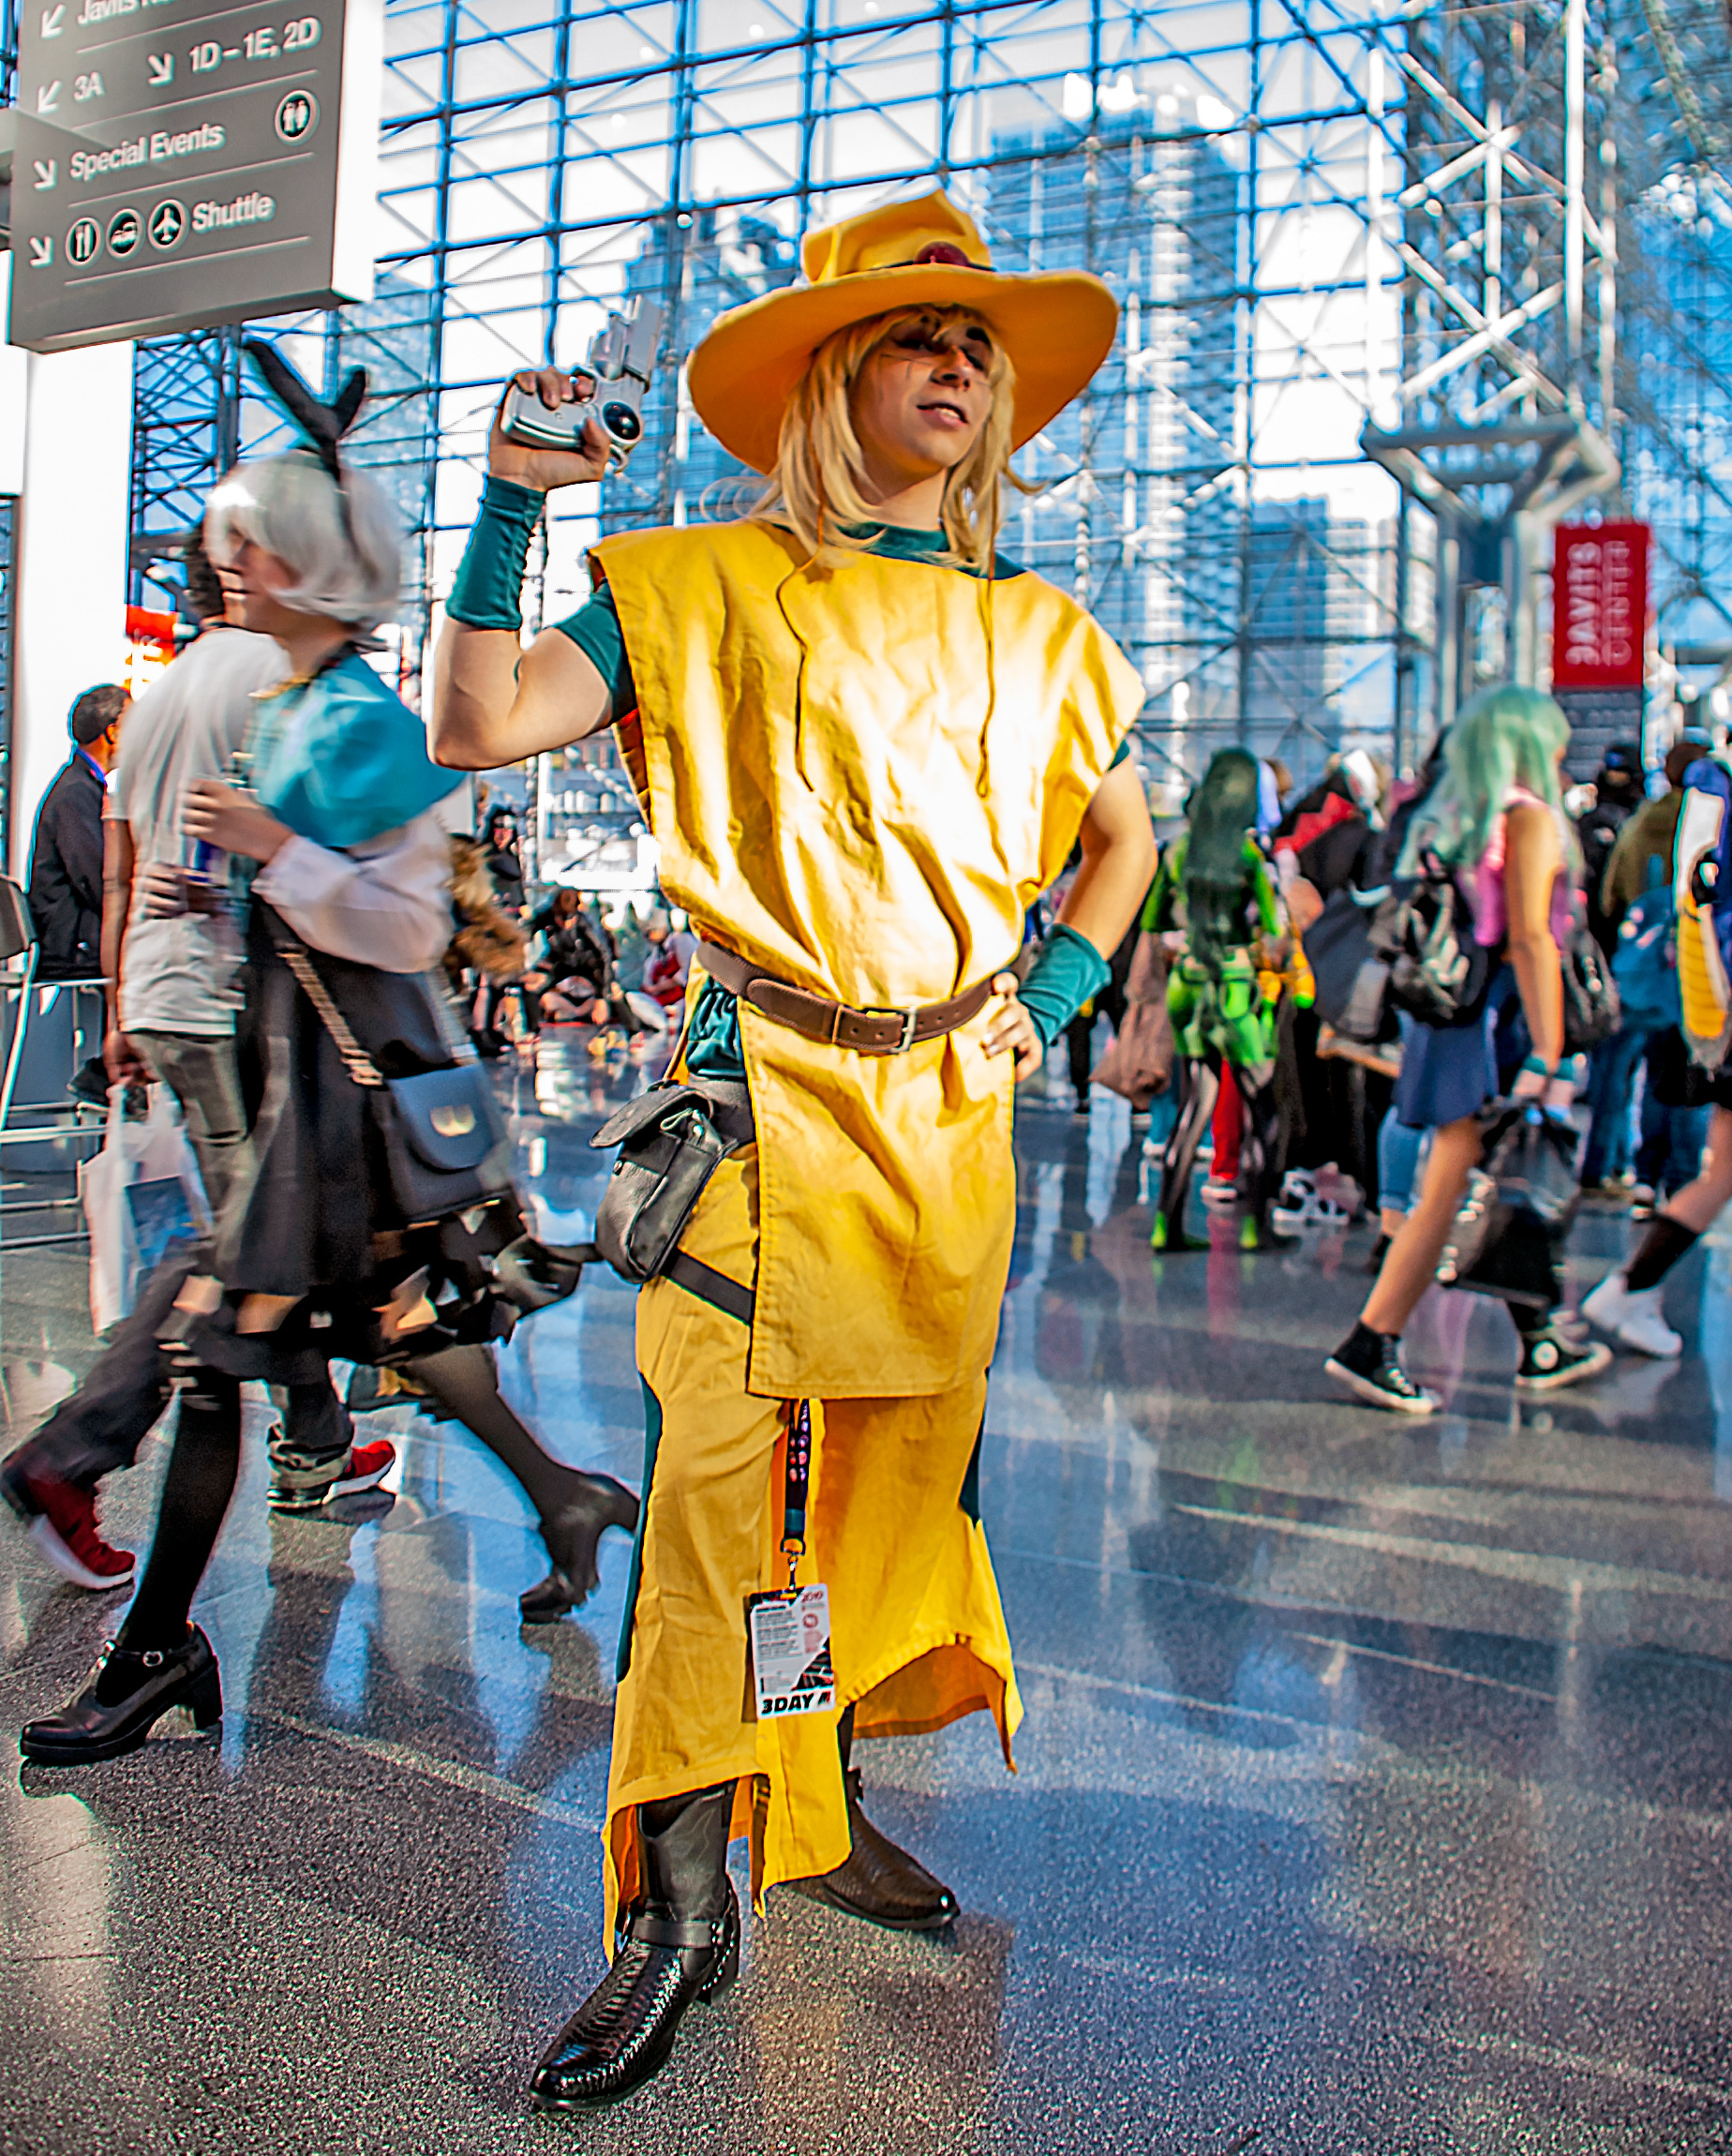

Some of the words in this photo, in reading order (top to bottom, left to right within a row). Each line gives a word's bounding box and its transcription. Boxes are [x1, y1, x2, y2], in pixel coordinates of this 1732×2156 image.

[283, 17, 322, 52] 2D
[74, 71, 105, 102] 3A
[69, 136, 148, 181] Special
[149, 123, 226, 162] Events
[192, 191, 276, 233] Shuttle
[761, 1692, 814, 1715] 3DAY
